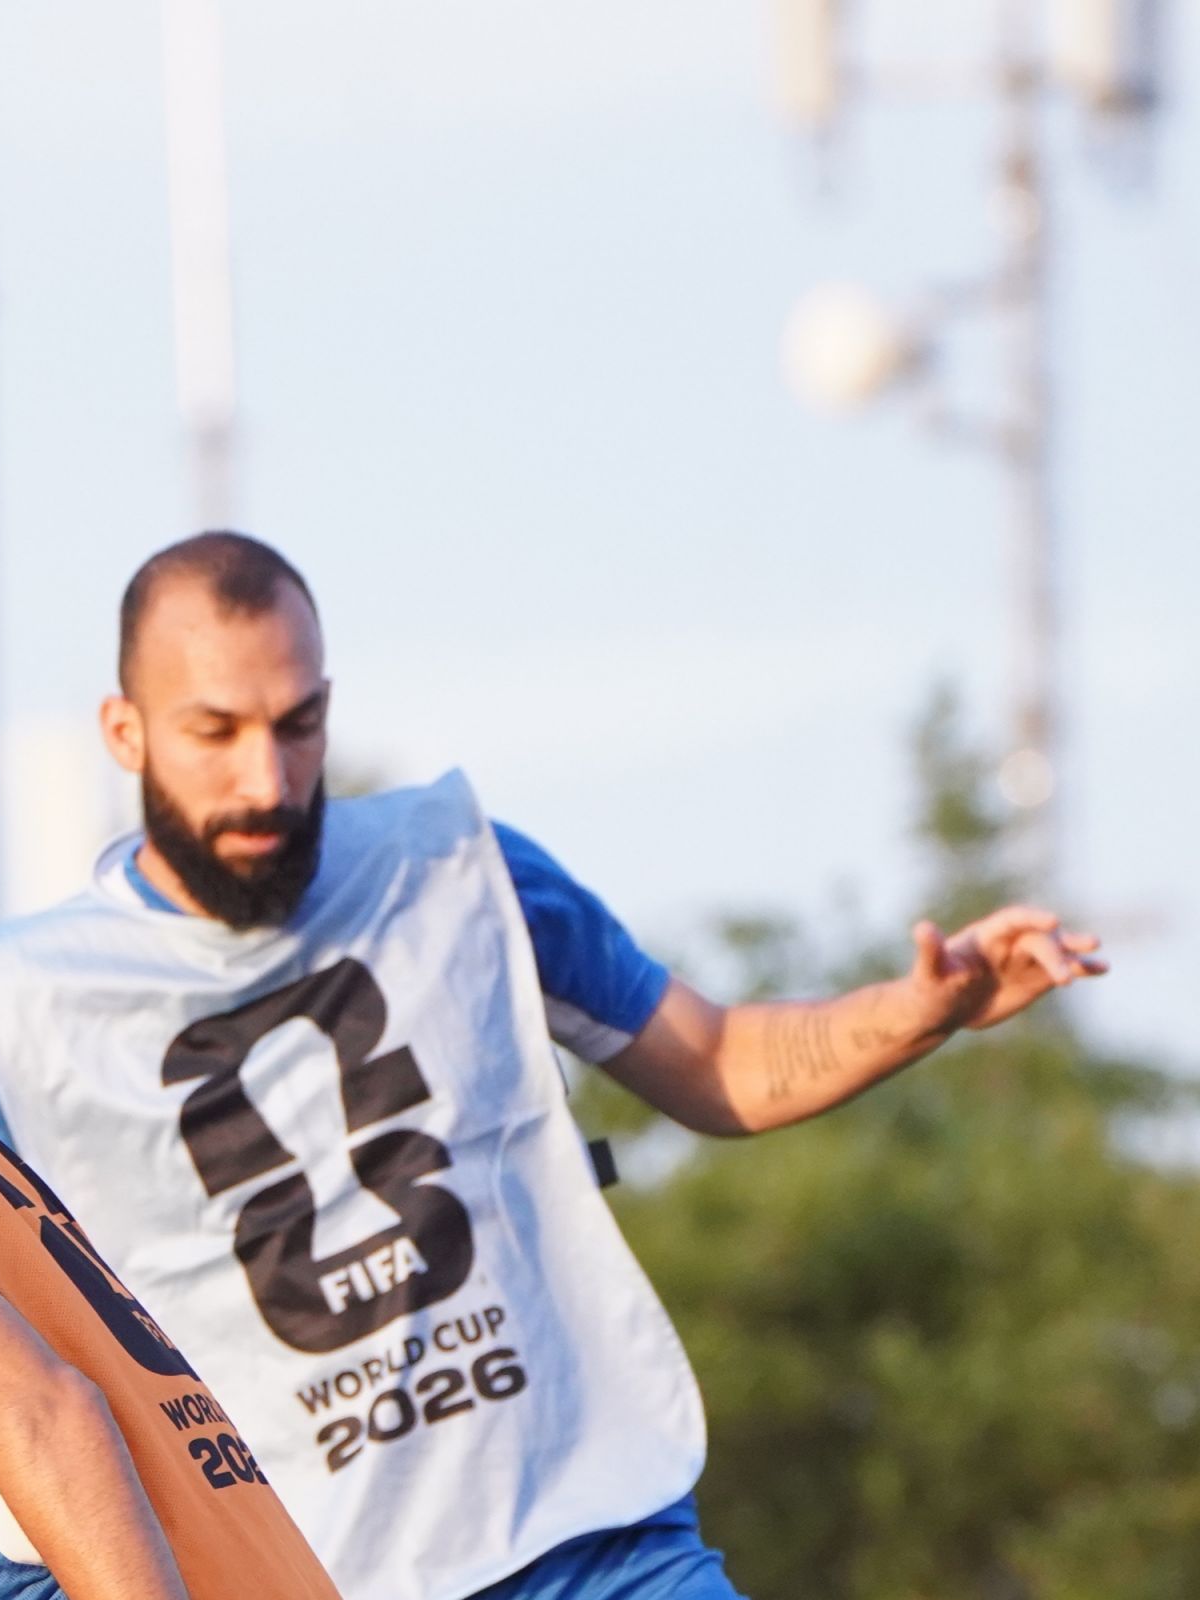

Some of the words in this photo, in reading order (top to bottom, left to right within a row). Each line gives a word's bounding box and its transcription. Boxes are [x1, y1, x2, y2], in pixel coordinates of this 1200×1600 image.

[318, 1235, 428, 1315] FIFA
[295, 1337, 425, 1415] WORLD
[432, 1304, 506, 1353] CUP
[159, 1393, 230, 1431] WORL
[316, 1347, 528, 1474] 2026
